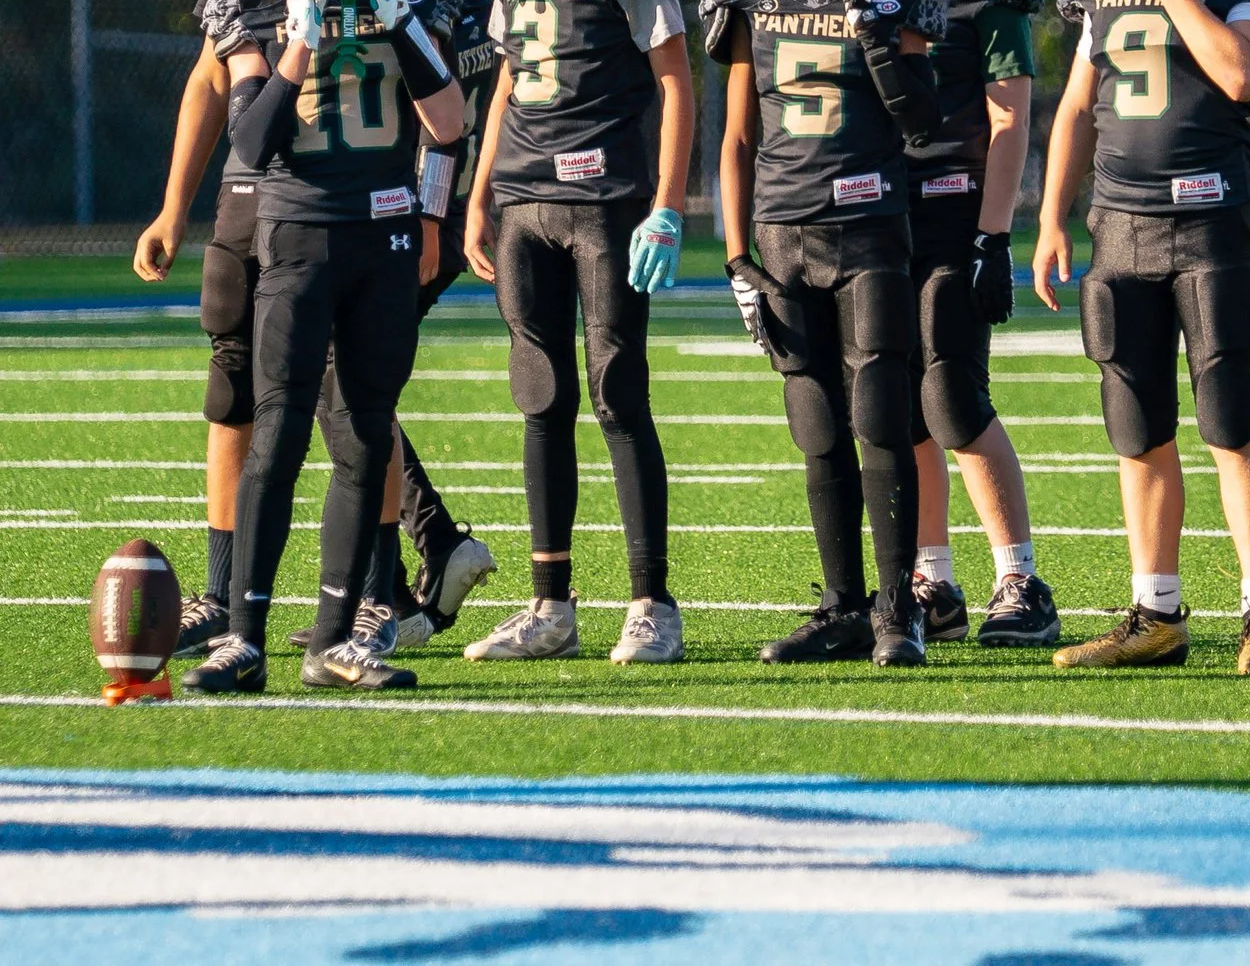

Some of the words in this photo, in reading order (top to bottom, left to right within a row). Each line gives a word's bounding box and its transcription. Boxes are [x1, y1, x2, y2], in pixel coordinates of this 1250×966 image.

[343, 7, 355, 38] NXTRND
[1103, 11, 1172, 119] 9
[774, 38, 846, 138] 5
[290, 41, 402, 155] 10
[560, 154, 596, 167] Riddell
[839, 178, 876, 192] Riddell
[927, 178, 963, 187] Riddell
[1179, 178, 1216, 190] Riddell
[376, 192, 406, 205] Riddell
